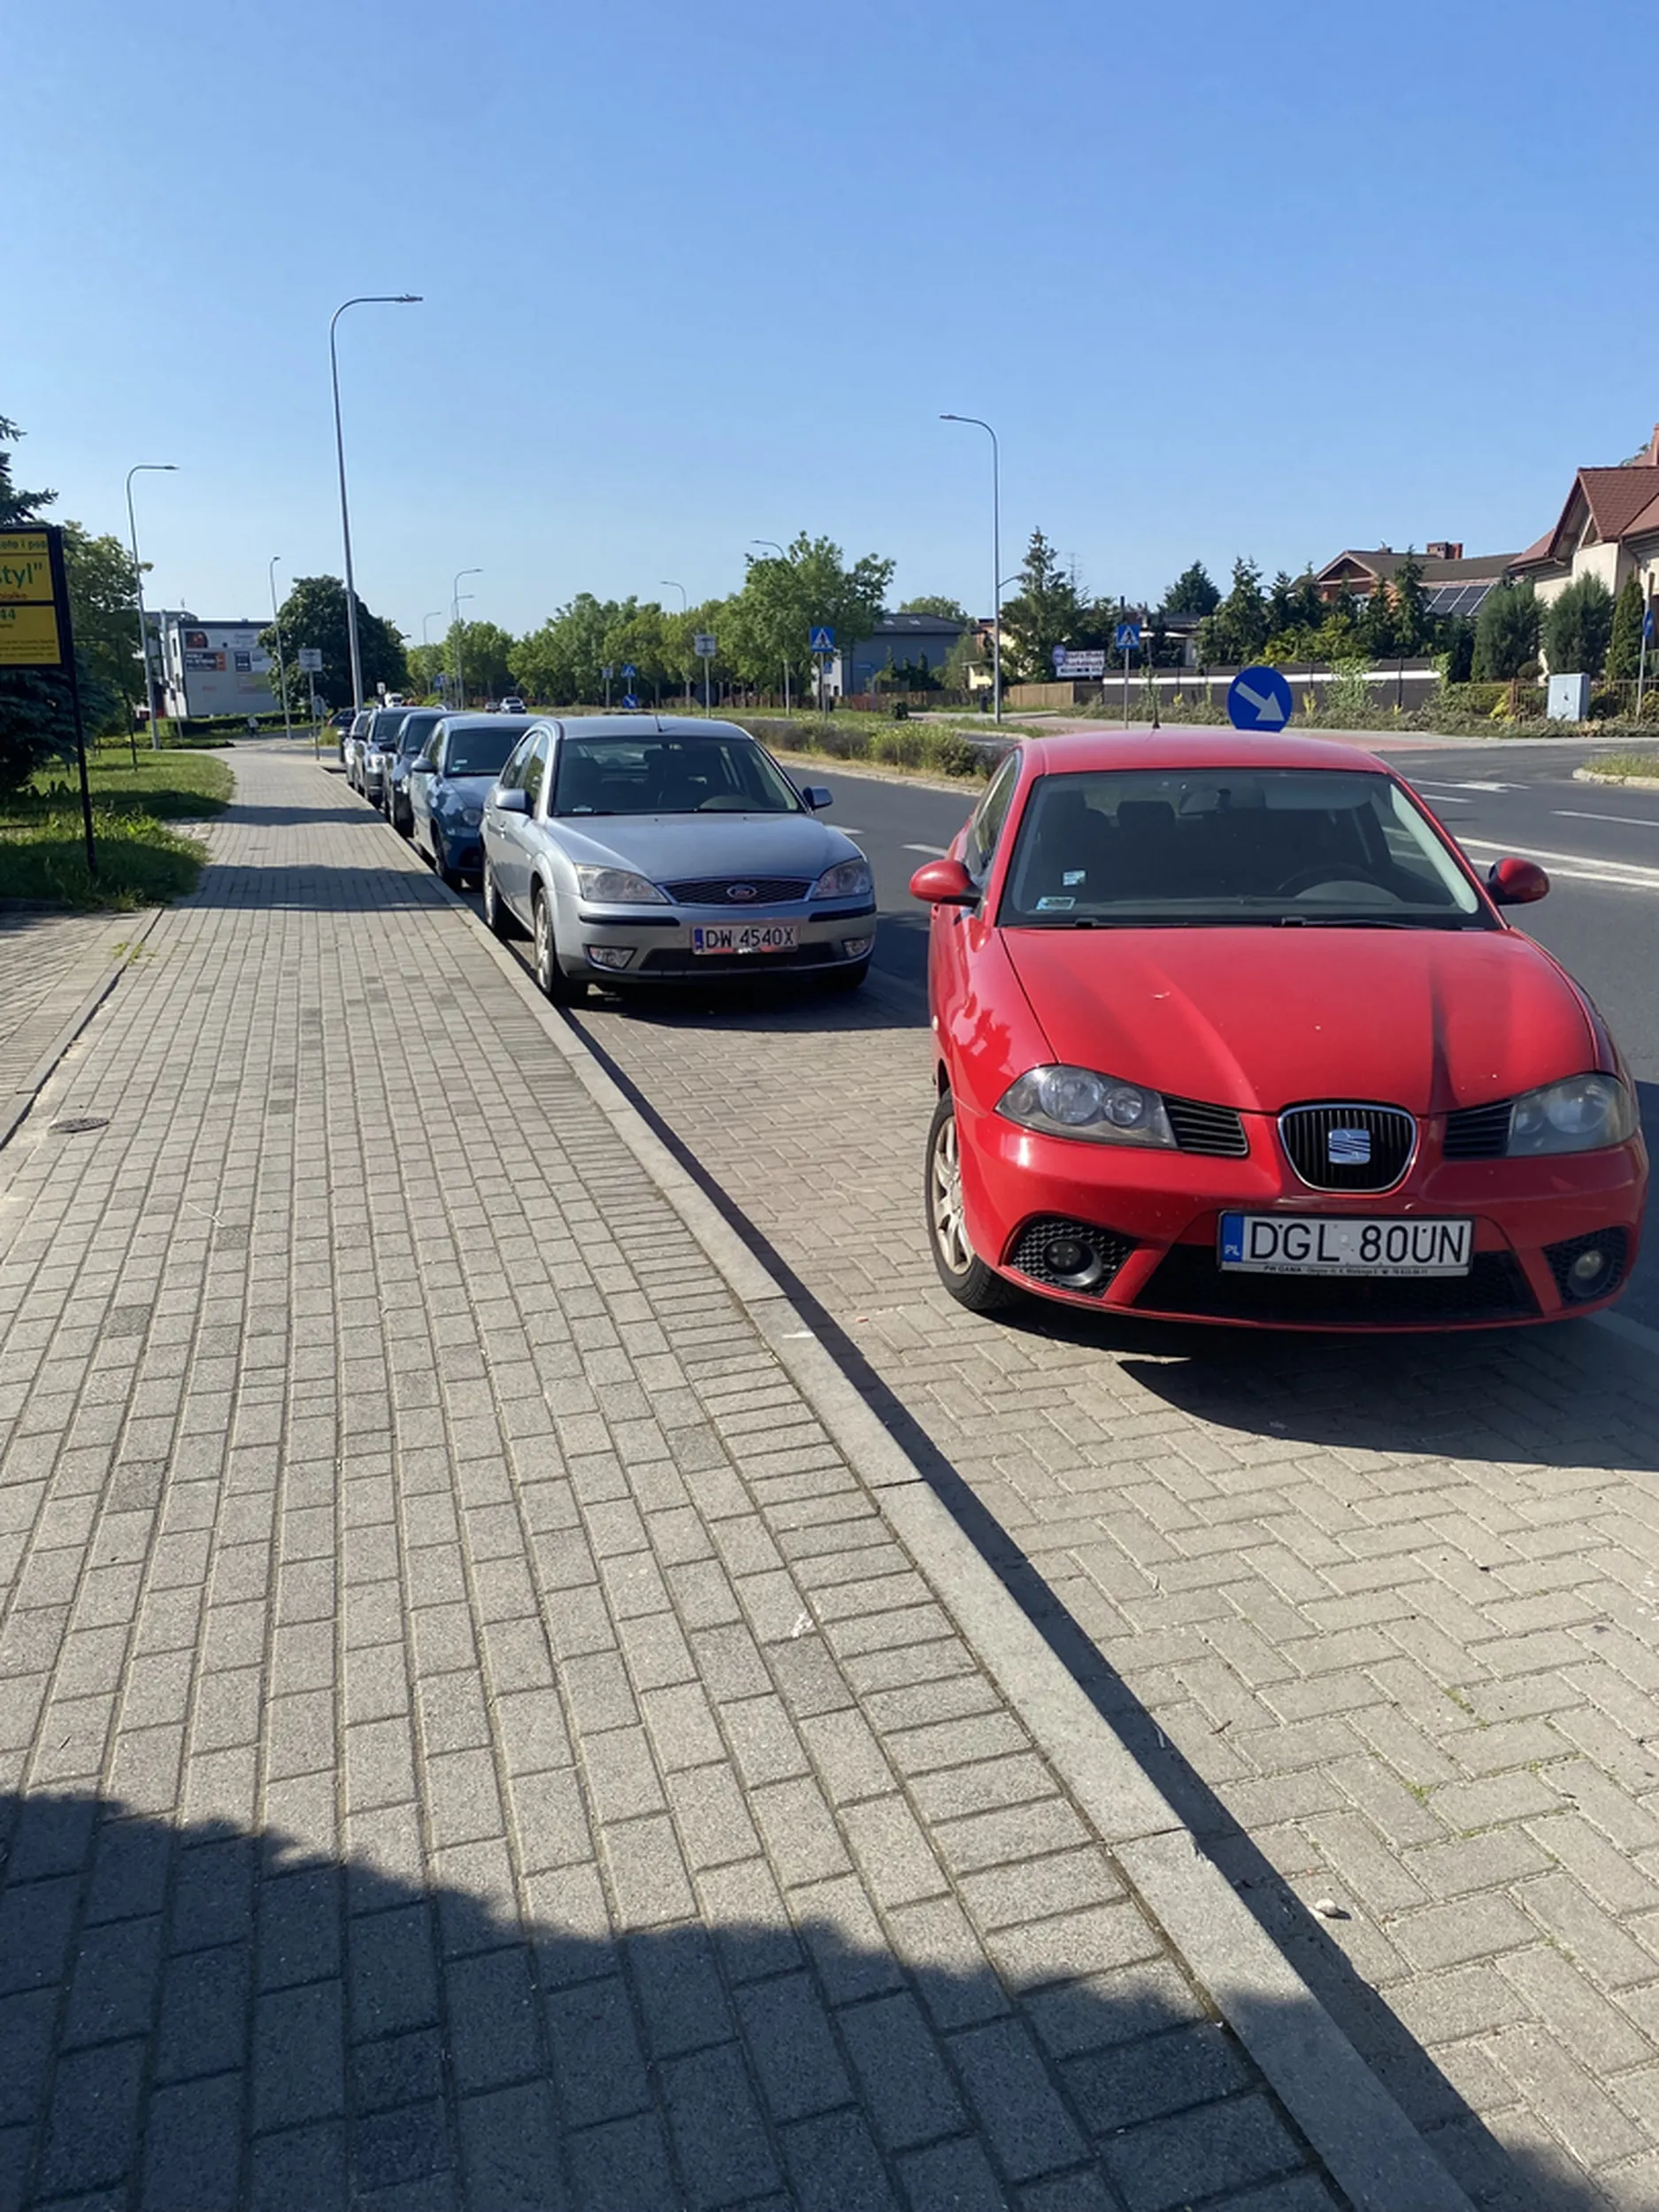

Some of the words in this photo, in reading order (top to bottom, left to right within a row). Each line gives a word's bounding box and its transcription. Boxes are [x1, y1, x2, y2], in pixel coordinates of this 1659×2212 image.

[0, 563, 42, 588] tyl"
[705, 929, 733, 948] DW
[739, 928, 794, 947] 4540X
[1225, 1244, 1240, 1256] PL
[1249, 1221, 1340, 1262] DGL
[1359, 1225, 1464, 1263] 80UN
